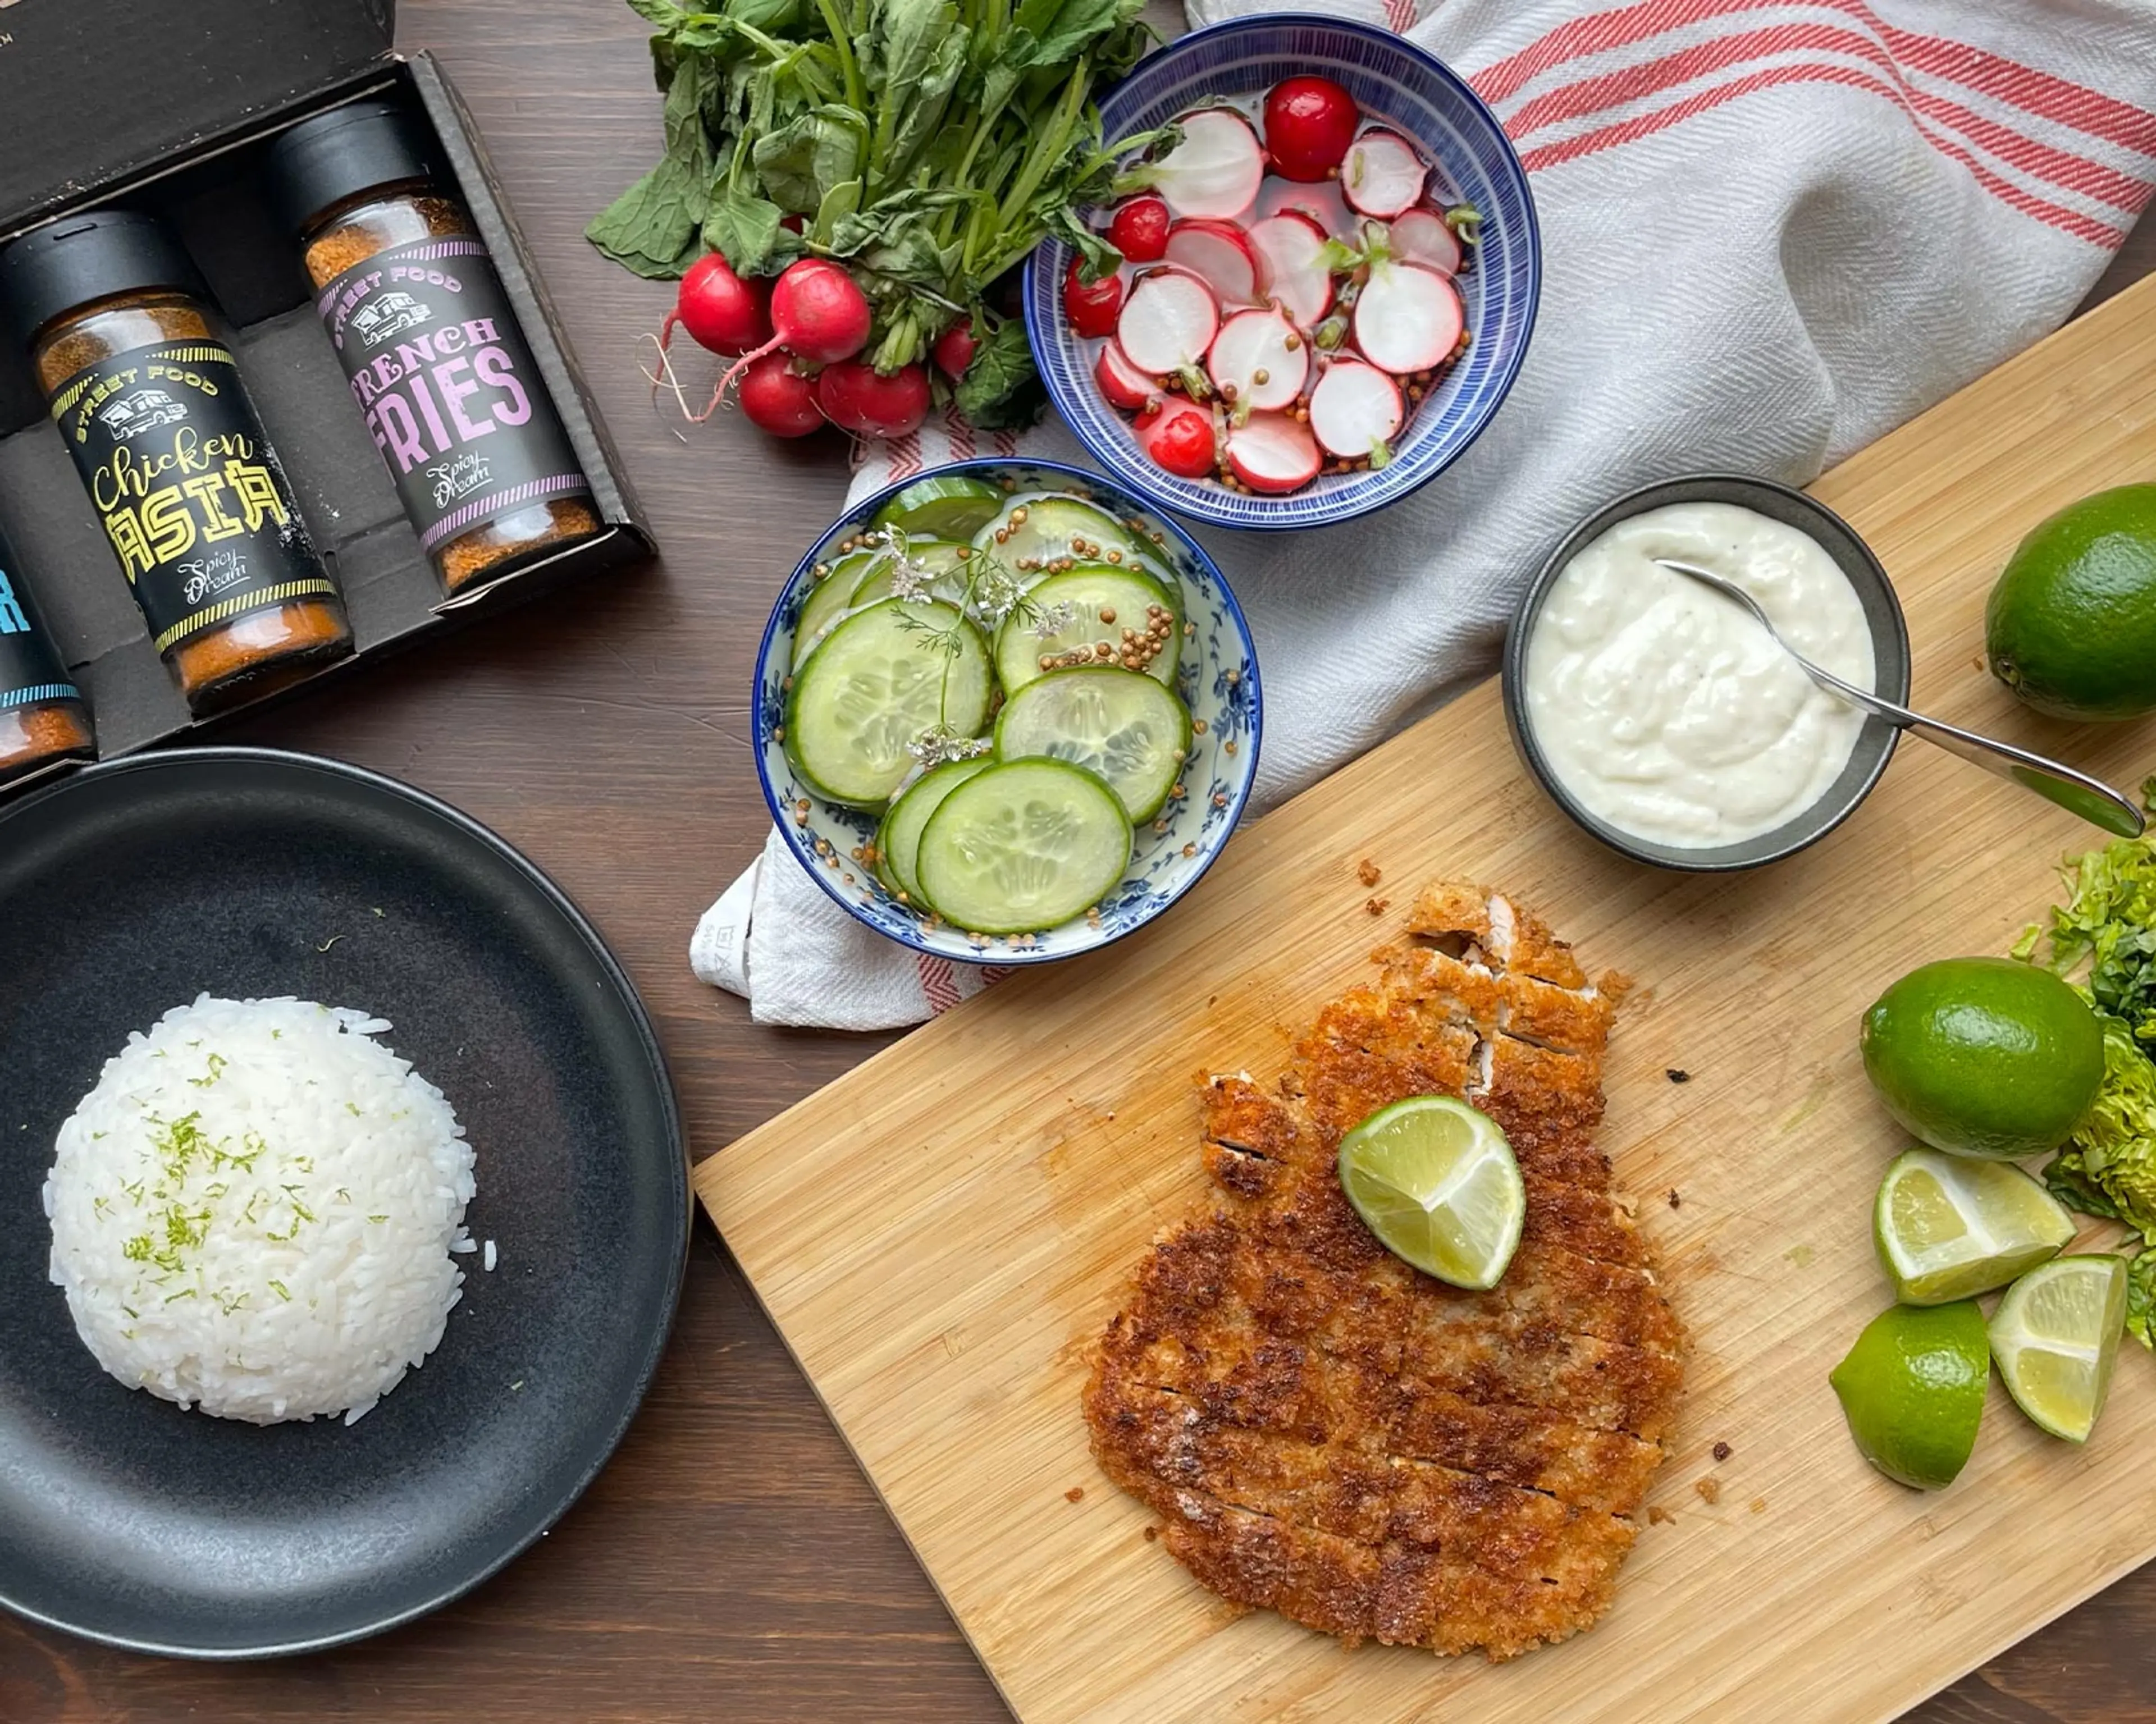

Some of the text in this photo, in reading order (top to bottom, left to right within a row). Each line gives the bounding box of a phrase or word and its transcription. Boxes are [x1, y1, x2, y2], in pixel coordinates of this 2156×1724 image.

[335, 266, 462, 350] STREET FOOD
[76, 365, 218, 443] STREET FOOD
[350, 318, 501, 414] FRENCH
[366, 346, 532, 487] FRIES
[94, 427, 254, 512] Chicken
[426, 450, 490, 488] Spicy
[433, 466, 494, 509] Dream
[105, 460, 289, 585] ASIA
[177, 548, 246, 585] Spicy
[184, 564, 251, 605] Dream
